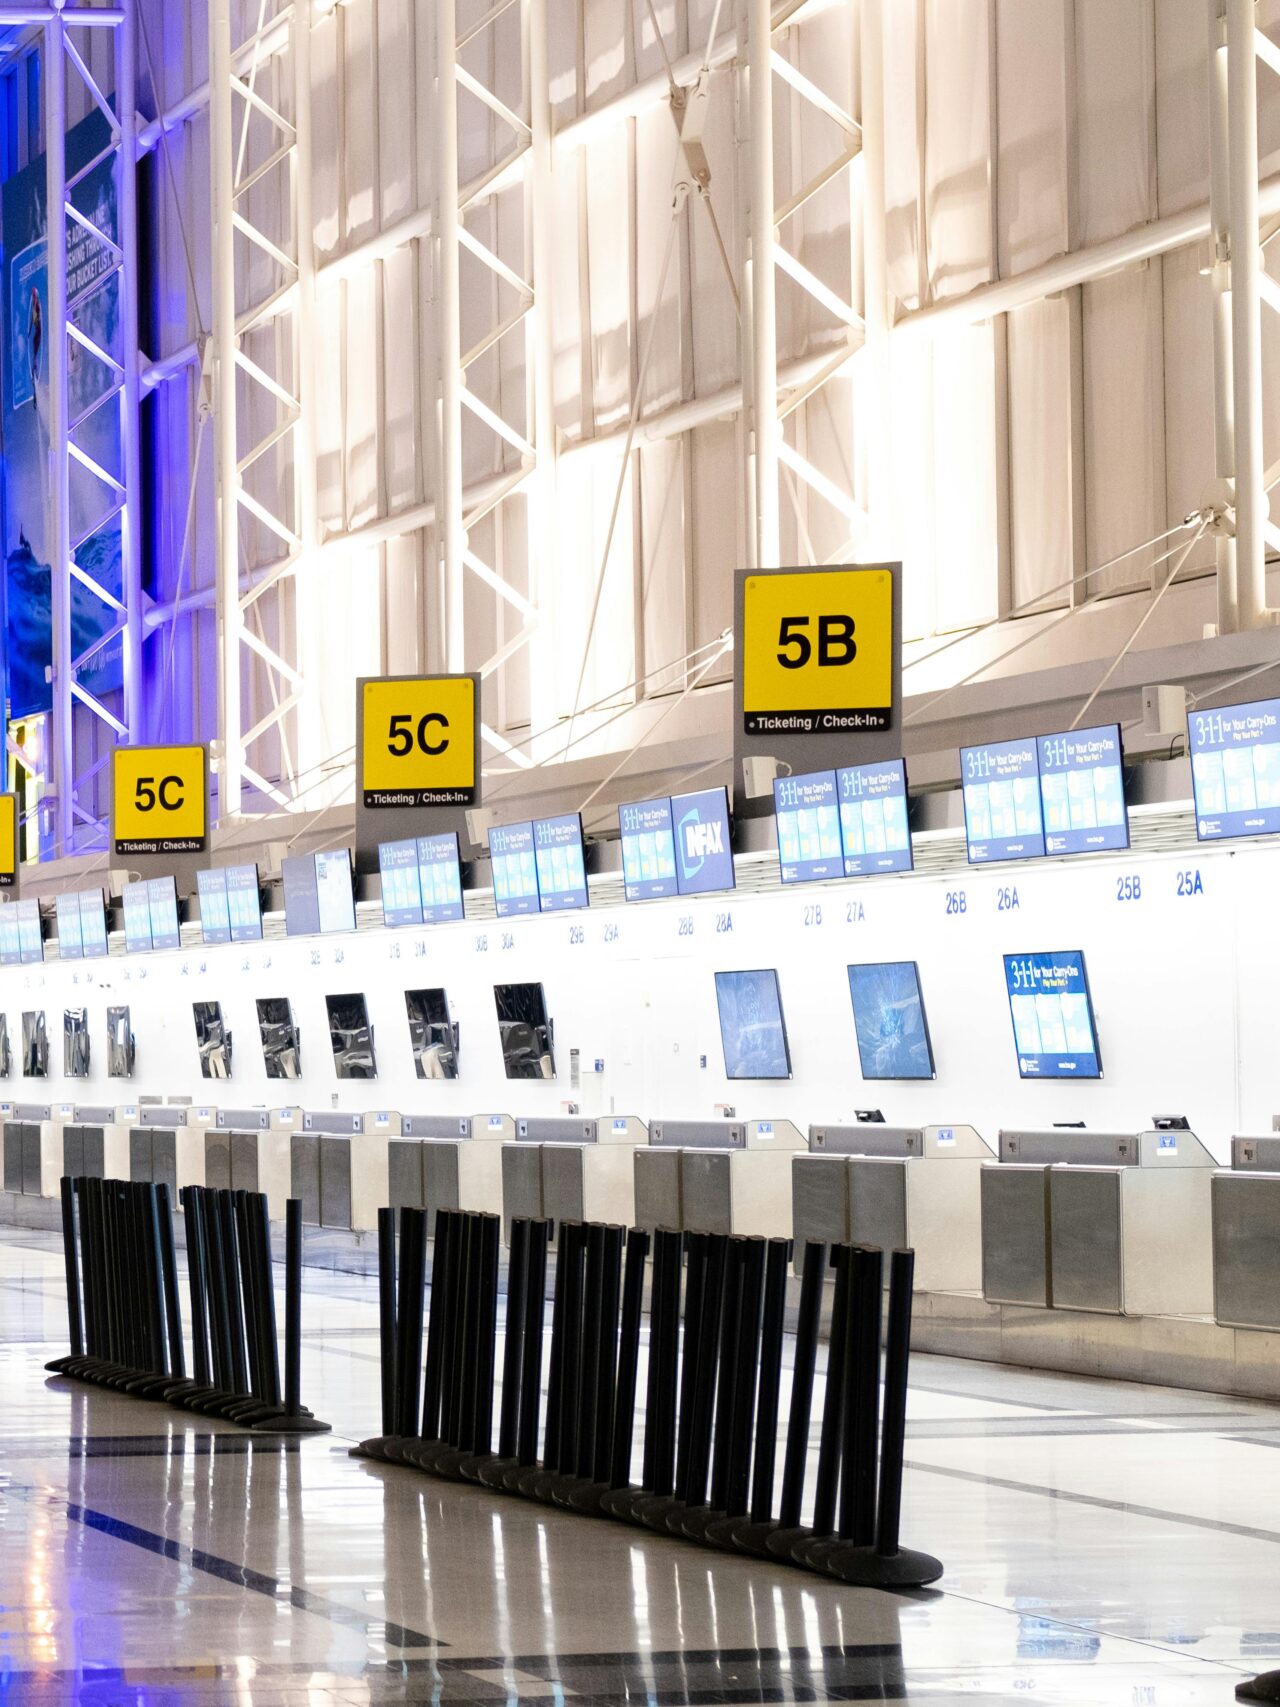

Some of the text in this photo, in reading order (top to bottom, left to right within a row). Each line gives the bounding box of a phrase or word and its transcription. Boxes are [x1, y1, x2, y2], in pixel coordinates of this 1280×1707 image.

[776, 614, 857, 669] 5B
[388, 712, 449, 757] 5C
[757, 716, 812, 731] Ticketing
[823, 714, 877, 727] Check-In
[1196, 713, 1224, 746] 3-1-1
[1232, 719, 1246, 731] Your
[1246, 714, 1276, 729] Carry-Ons
[967, 750, 990, 778] 3-1-1
[1044, 738, 1069, 768] 3-1-1
[1076, 742, 1087, 753] Your
[1088, 739, 1114, 753] Carry-Ons
[135, 775, 185, 812] 5C
[779, 781, 798, 806] 3-1-1
[842, 770, 863, 797] 3-1-1
[373, 793, 414, 805] Ticketing
[422, 792, 464, 802] Check-In
[123, 842, 157, 852] Ticketing
[162, 841, 196, 850] Check-In
[685, 821, 724, 858] INFAX
[1116, 869, 1204, 901] 25B 25A
[804, 902, 865, 926] 27B 27A
[946, 886, 1020, 915] 26B 26A
[570, 923, 619, 944] 29B 29A
[716, 912, 733, 933] 28A
[502, 932, 515, 950] 30A
[1011, 960, 1036, 988] 3-1-1
[1041, 966, 1052, 978] Your
[1054, 965, 1079, 978] Carry-Ons
